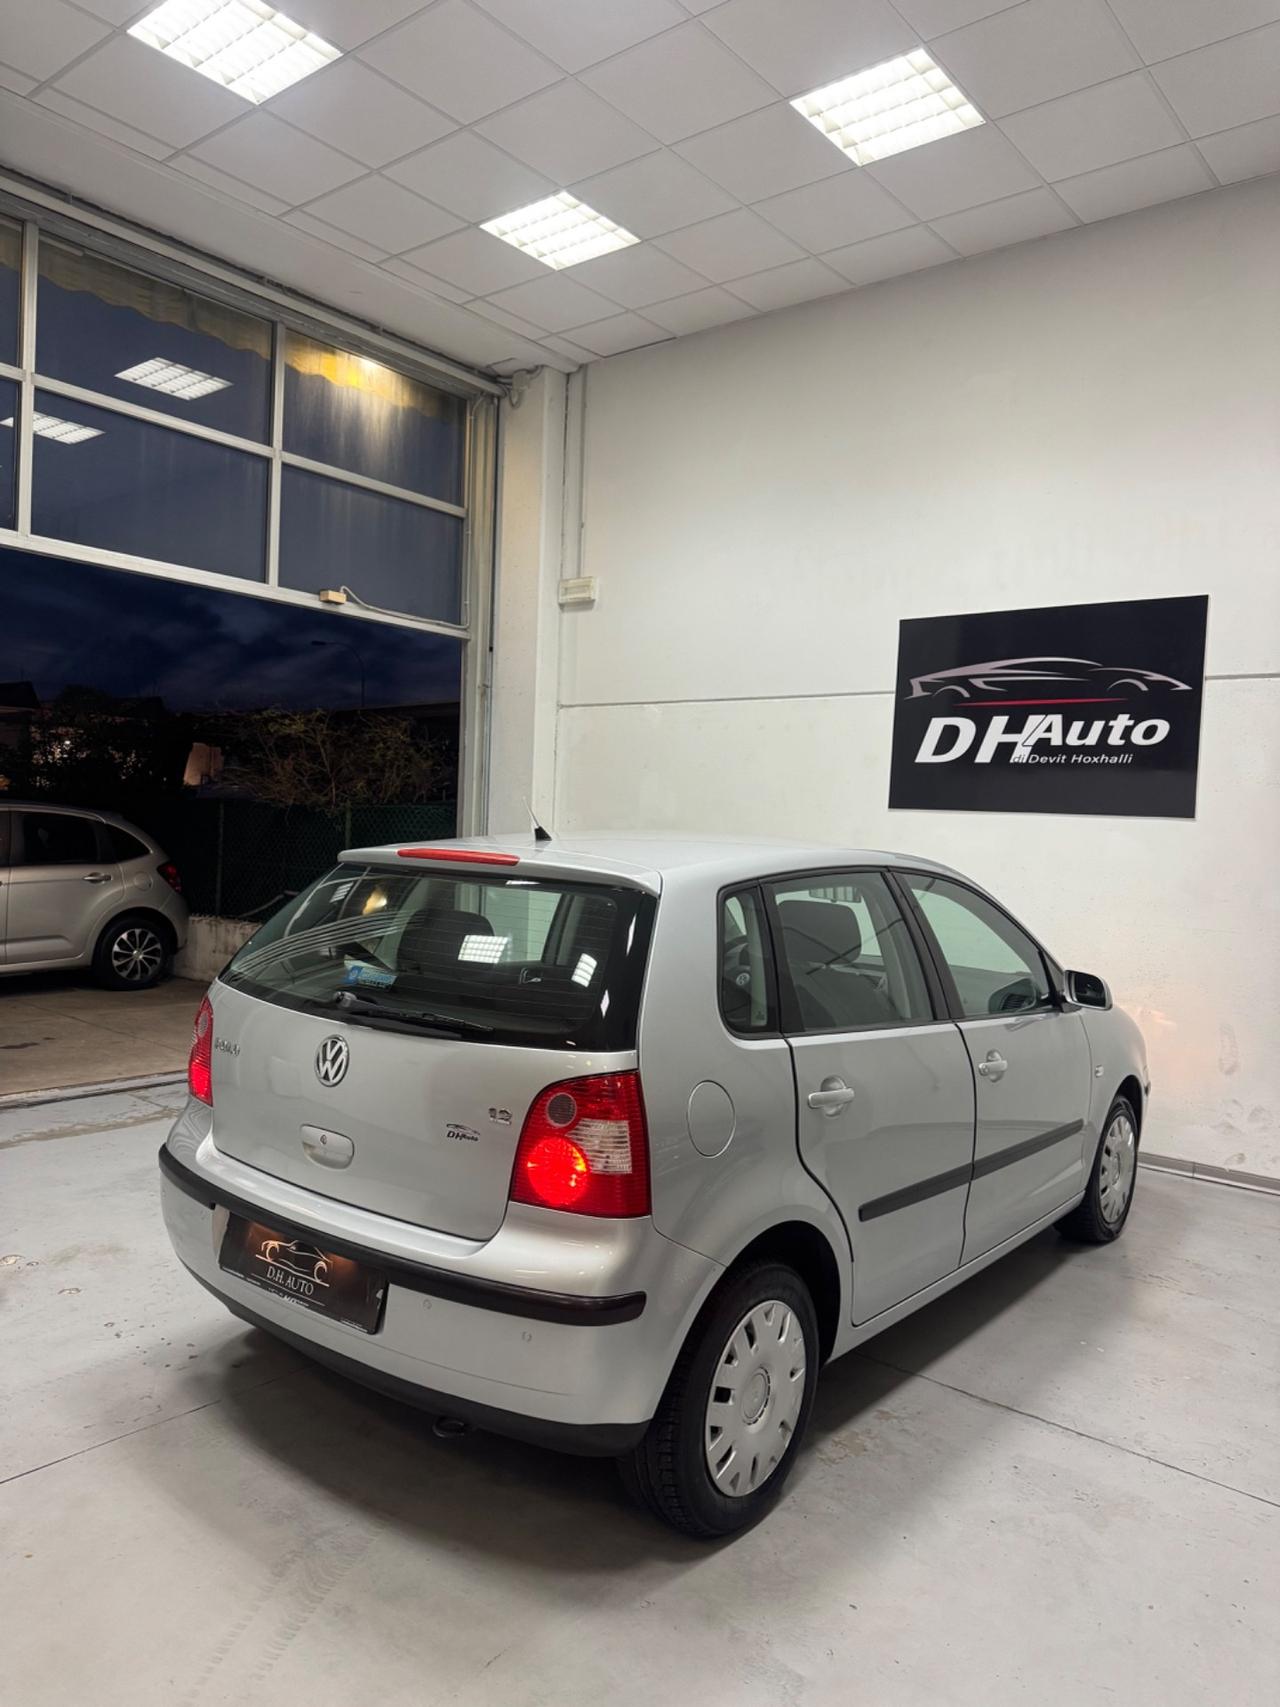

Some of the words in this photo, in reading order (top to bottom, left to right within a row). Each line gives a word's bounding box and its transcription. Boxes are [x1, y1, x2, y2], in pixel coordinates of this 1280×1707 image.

[1028, 754, 1068, 764] Devit
[1071, 753, 1134, 764] Hoxhalli
[285, 1275, 314, 1296] AUTO
